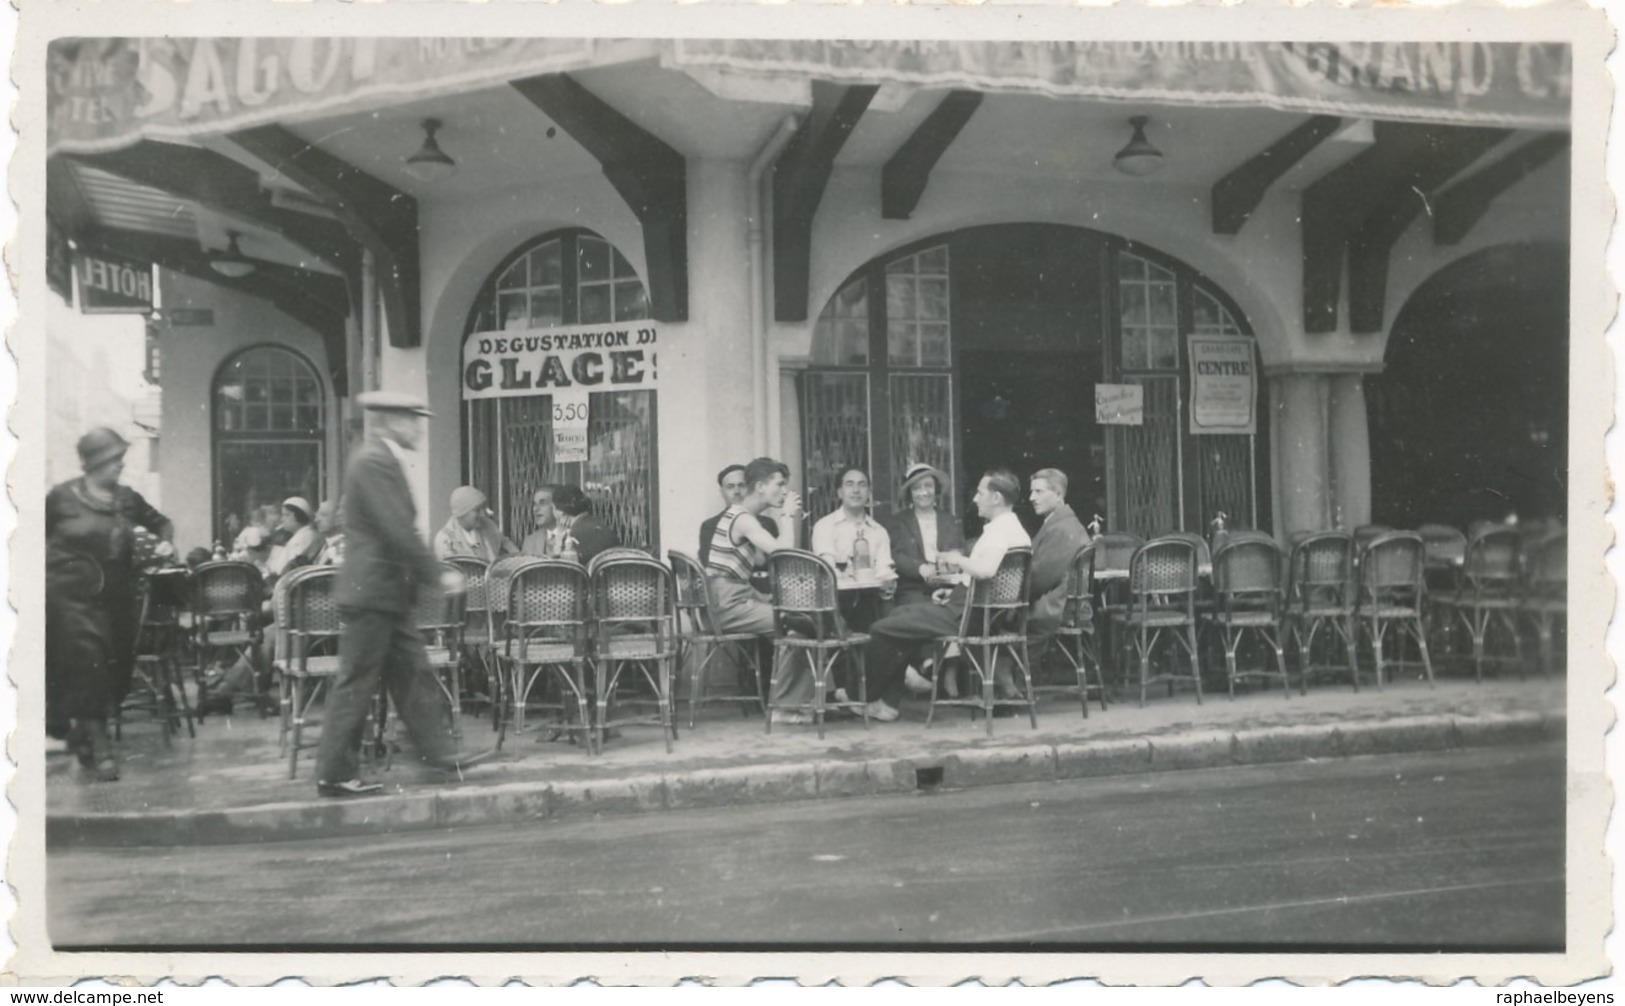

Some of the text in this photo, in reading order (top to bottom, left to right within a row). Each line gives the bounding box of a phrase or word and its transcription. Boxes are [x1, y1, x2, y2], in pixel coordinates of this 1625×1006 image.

[478, 330, 629, 355] DEGUSTATION
[465, 350, 657, 391] GLACE
[1197, 361, 1250, 376] CENTRE
